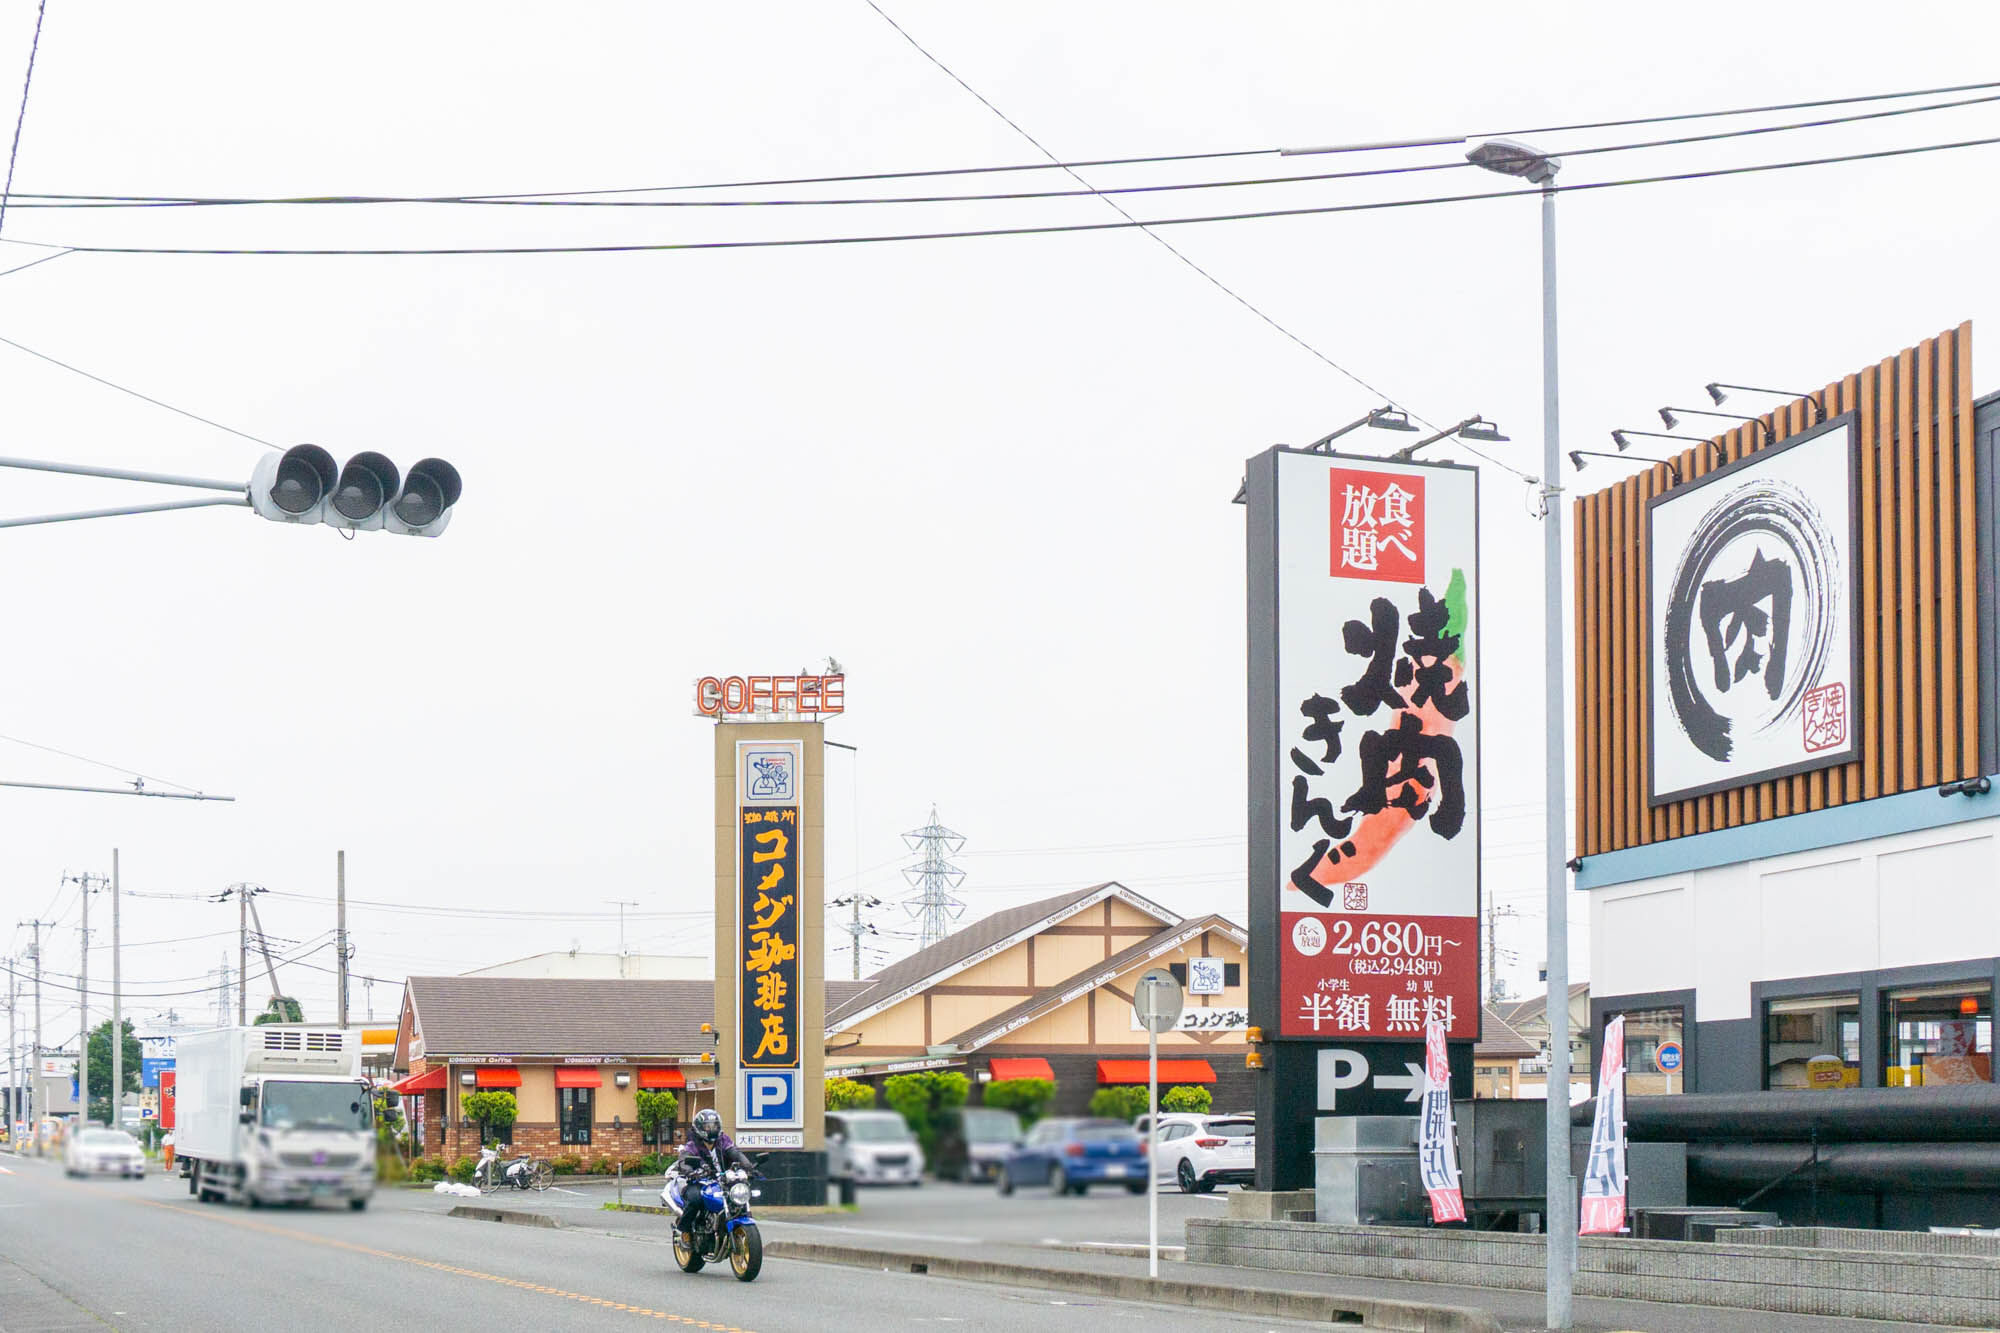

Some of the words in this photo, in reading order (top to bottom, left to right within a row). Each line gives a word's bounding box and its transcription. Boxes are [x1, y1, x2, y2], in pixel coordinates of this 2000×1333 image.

[1700, 545, 1793, 701] 肉
[697, 674, 845, 714] COFFEE
[1291, 693, 1357, 908] きんぐ
[746, 829, 796, 1059] コメダ珈琲店
[1317, 979, 1350, 991] 小学生
[1184, 1011, 1248, 1028] コメダ珈
[1299, 993, 1371, 1031] 半額
[1386, 994, 1457, 1032] 無料
[752, 1077, 788, 1117] P
[1317, 1049, 1369, 1110] P
[142, 1109, 152, 1117] P
[740, 1136, 800, 1145] 大和下和田FC店
